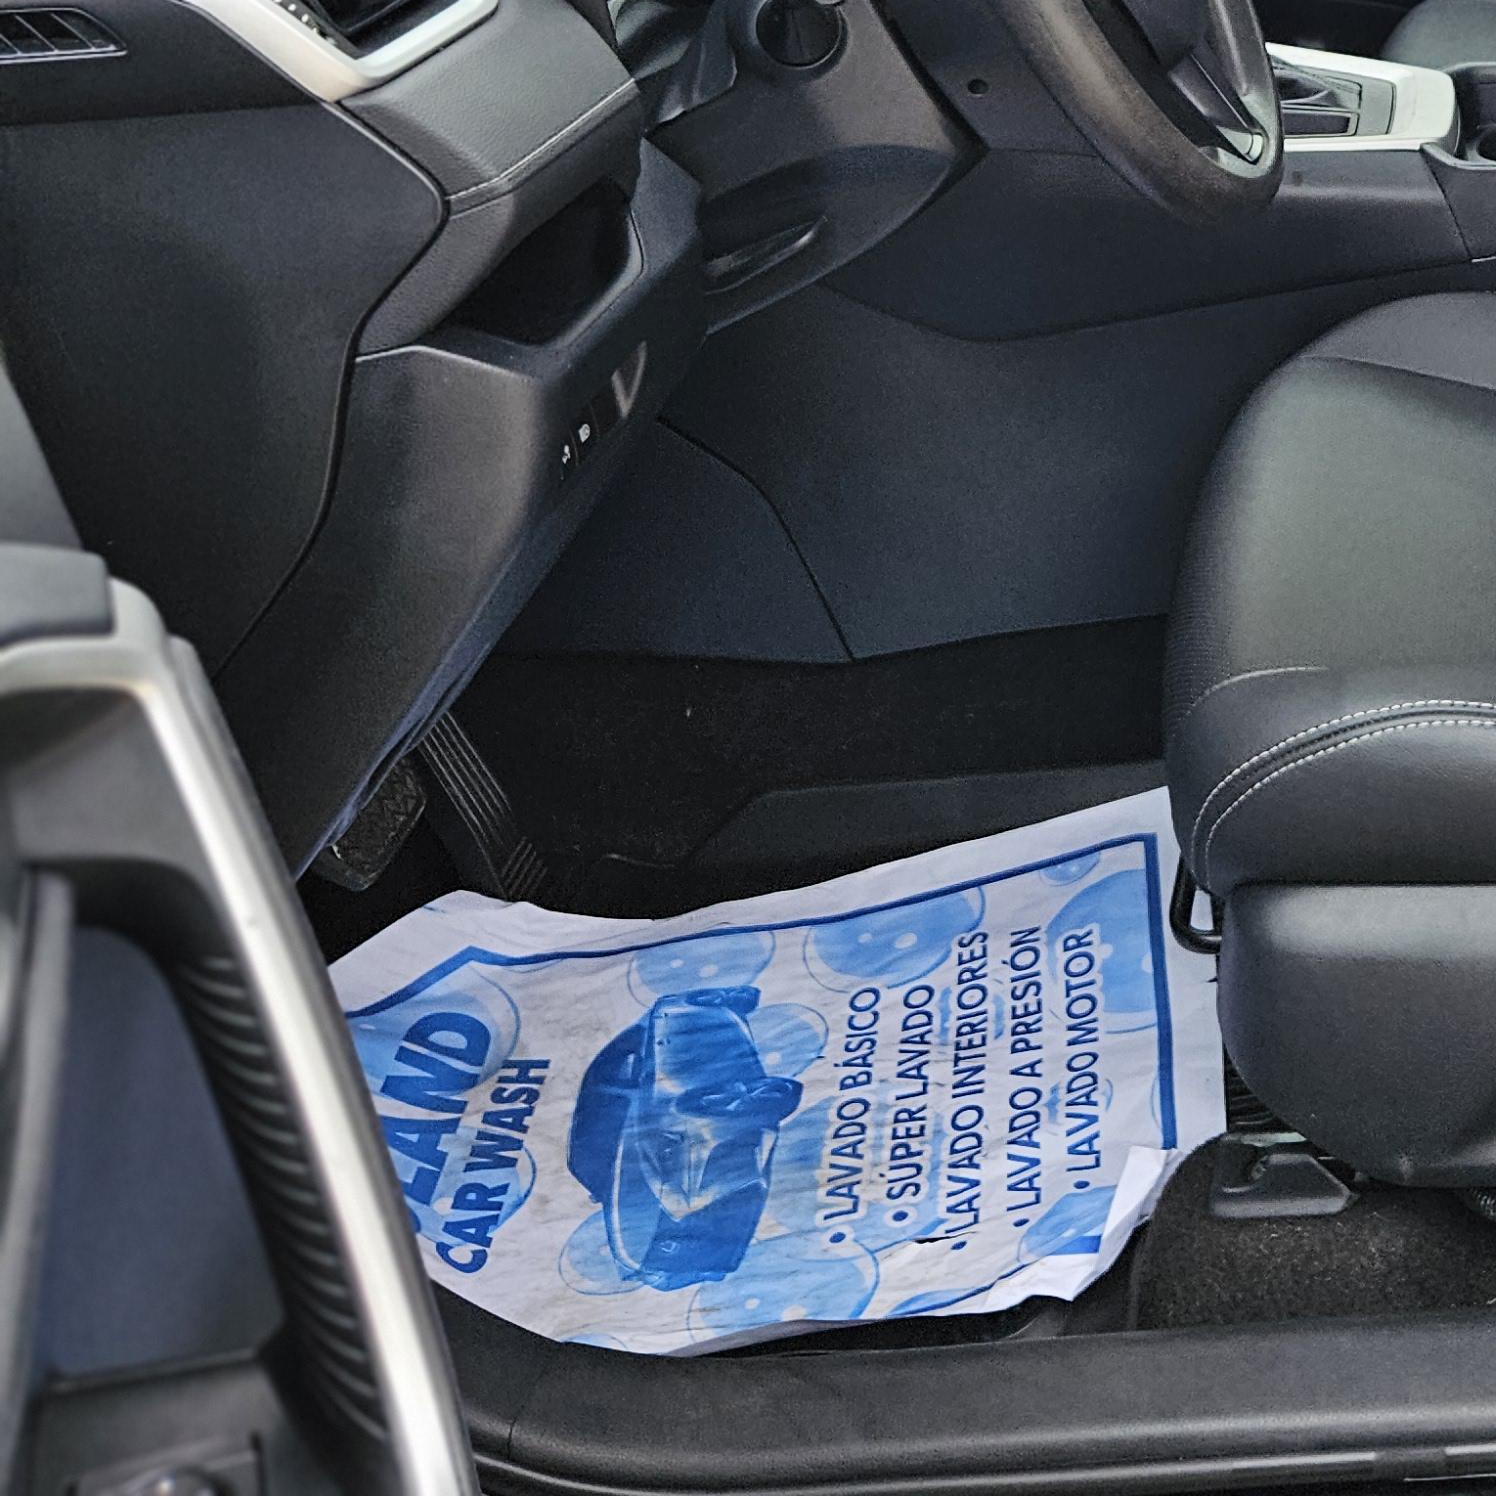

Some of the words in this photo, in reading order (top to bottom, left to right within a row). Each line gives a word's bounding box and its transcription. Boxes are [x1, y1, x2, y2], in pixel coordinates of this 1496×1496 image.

[834, 986, 881, 1090] BÁSICO
[893, 984, 934, 1101] LAVADO
[950, 931, 990, 1099] INTERIORES
[1001, 924, 1044, 1055] PRESIÓN
[1063, 928, 1099, 1046] MOTOR
[464, 1059, 551, 1173] WASH
[1009, 1059, 1042, 1078] A
[1065, 1052, 1102, 1172] LAVADO
[823, 1097, 871, 1221] LAVADO
[879, 1104, 928, 1200] SÚPER
[944, 1104, 984, 1234] LAVADO
[1006, 1087, 1042, 1212] LAVADO
[434, 1182, 511, 1274] CAR
